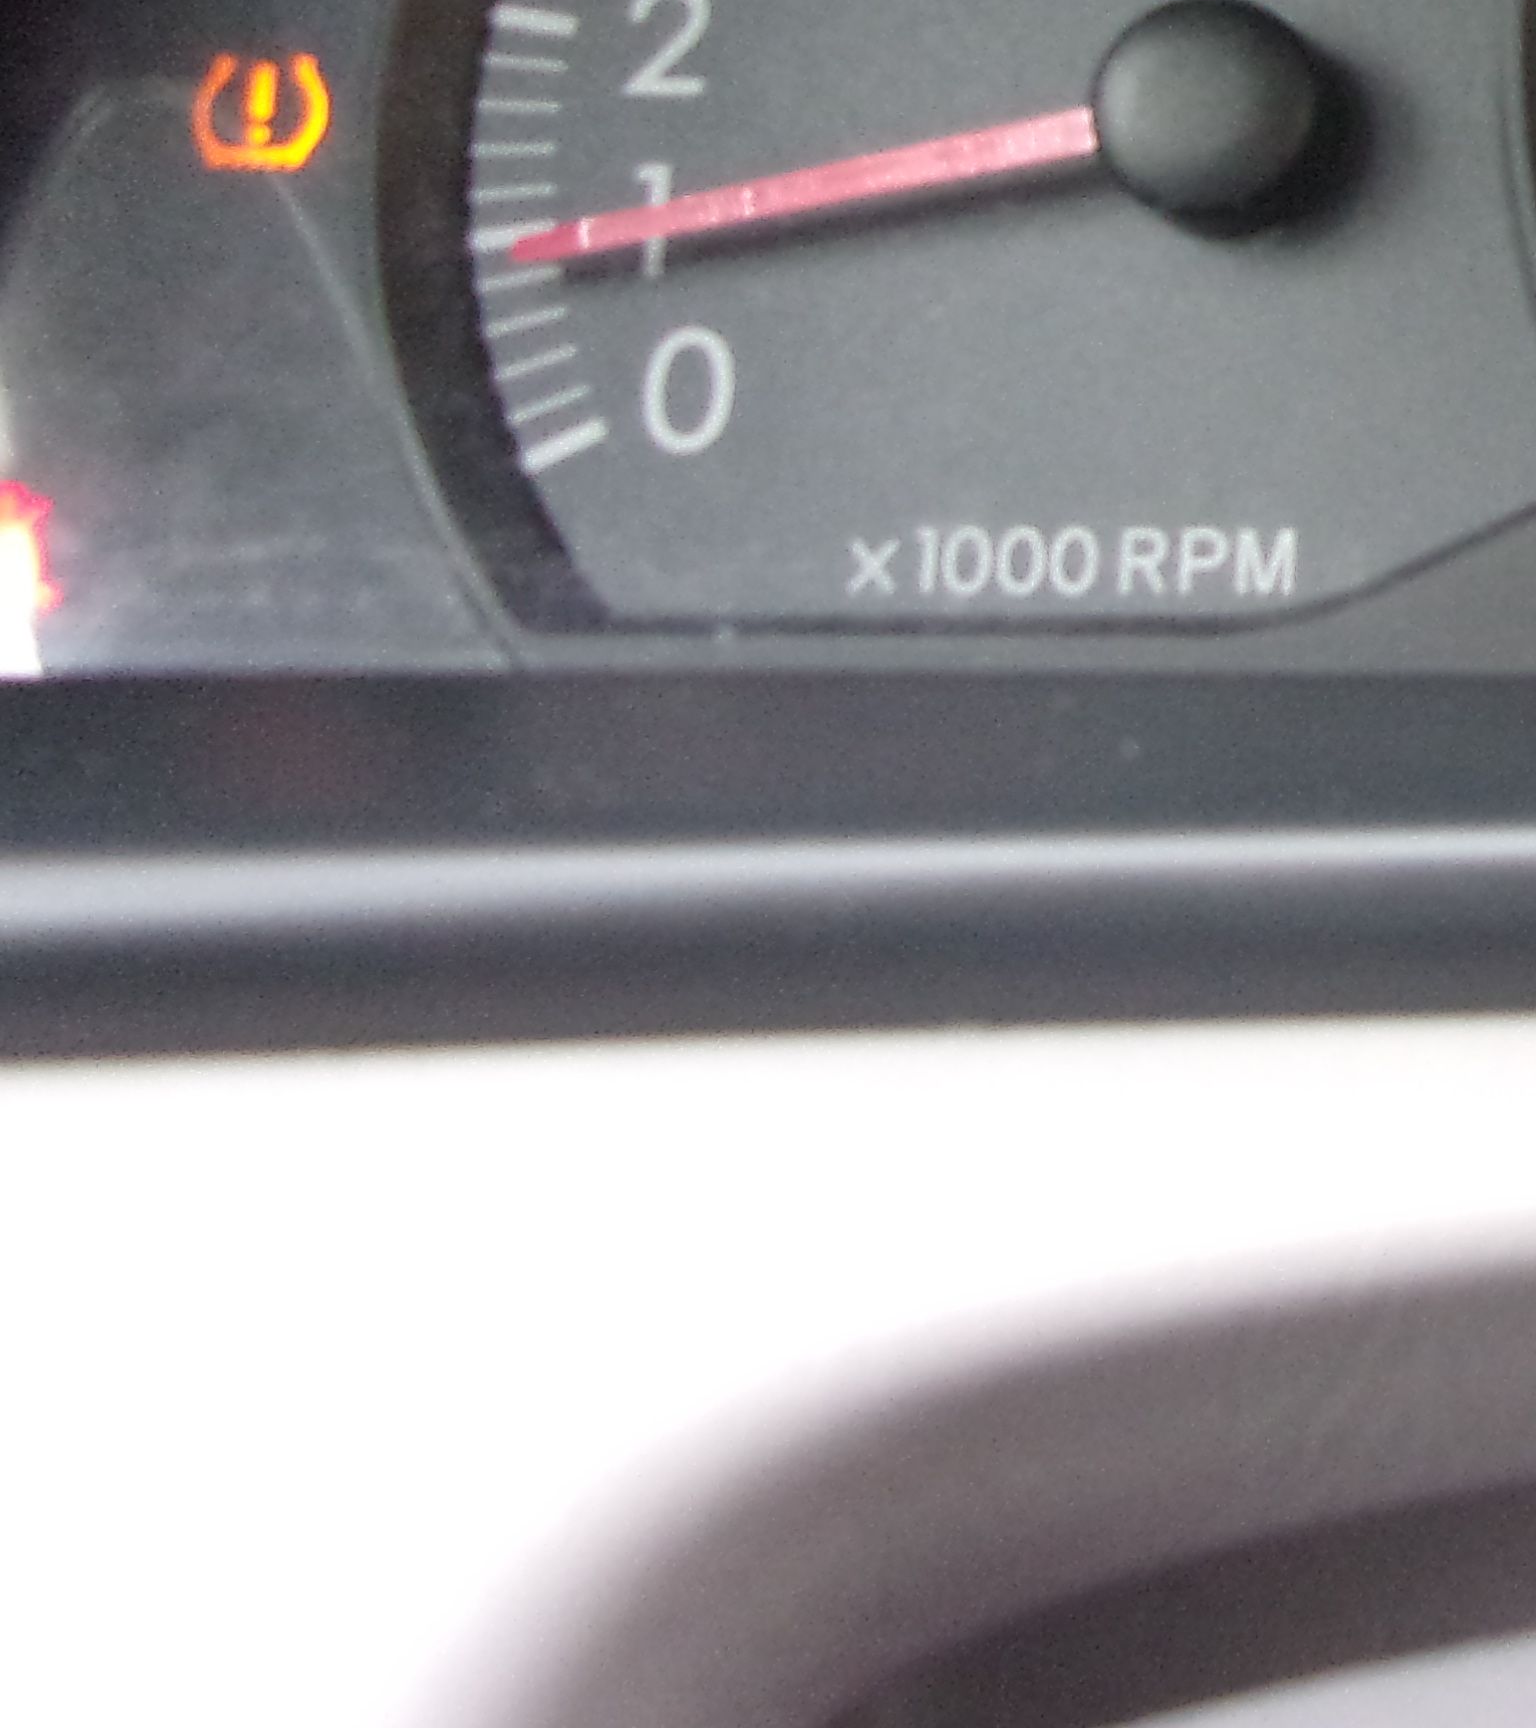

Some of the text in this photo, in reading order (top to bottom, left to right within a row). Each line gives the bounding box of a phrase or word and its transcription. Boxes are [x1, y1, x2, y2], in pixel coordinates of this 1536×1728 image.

[635, 162, 676, 276] 1
[642, 326, 735, 455] 0
[1117, 526, 1296, 595] RPM
